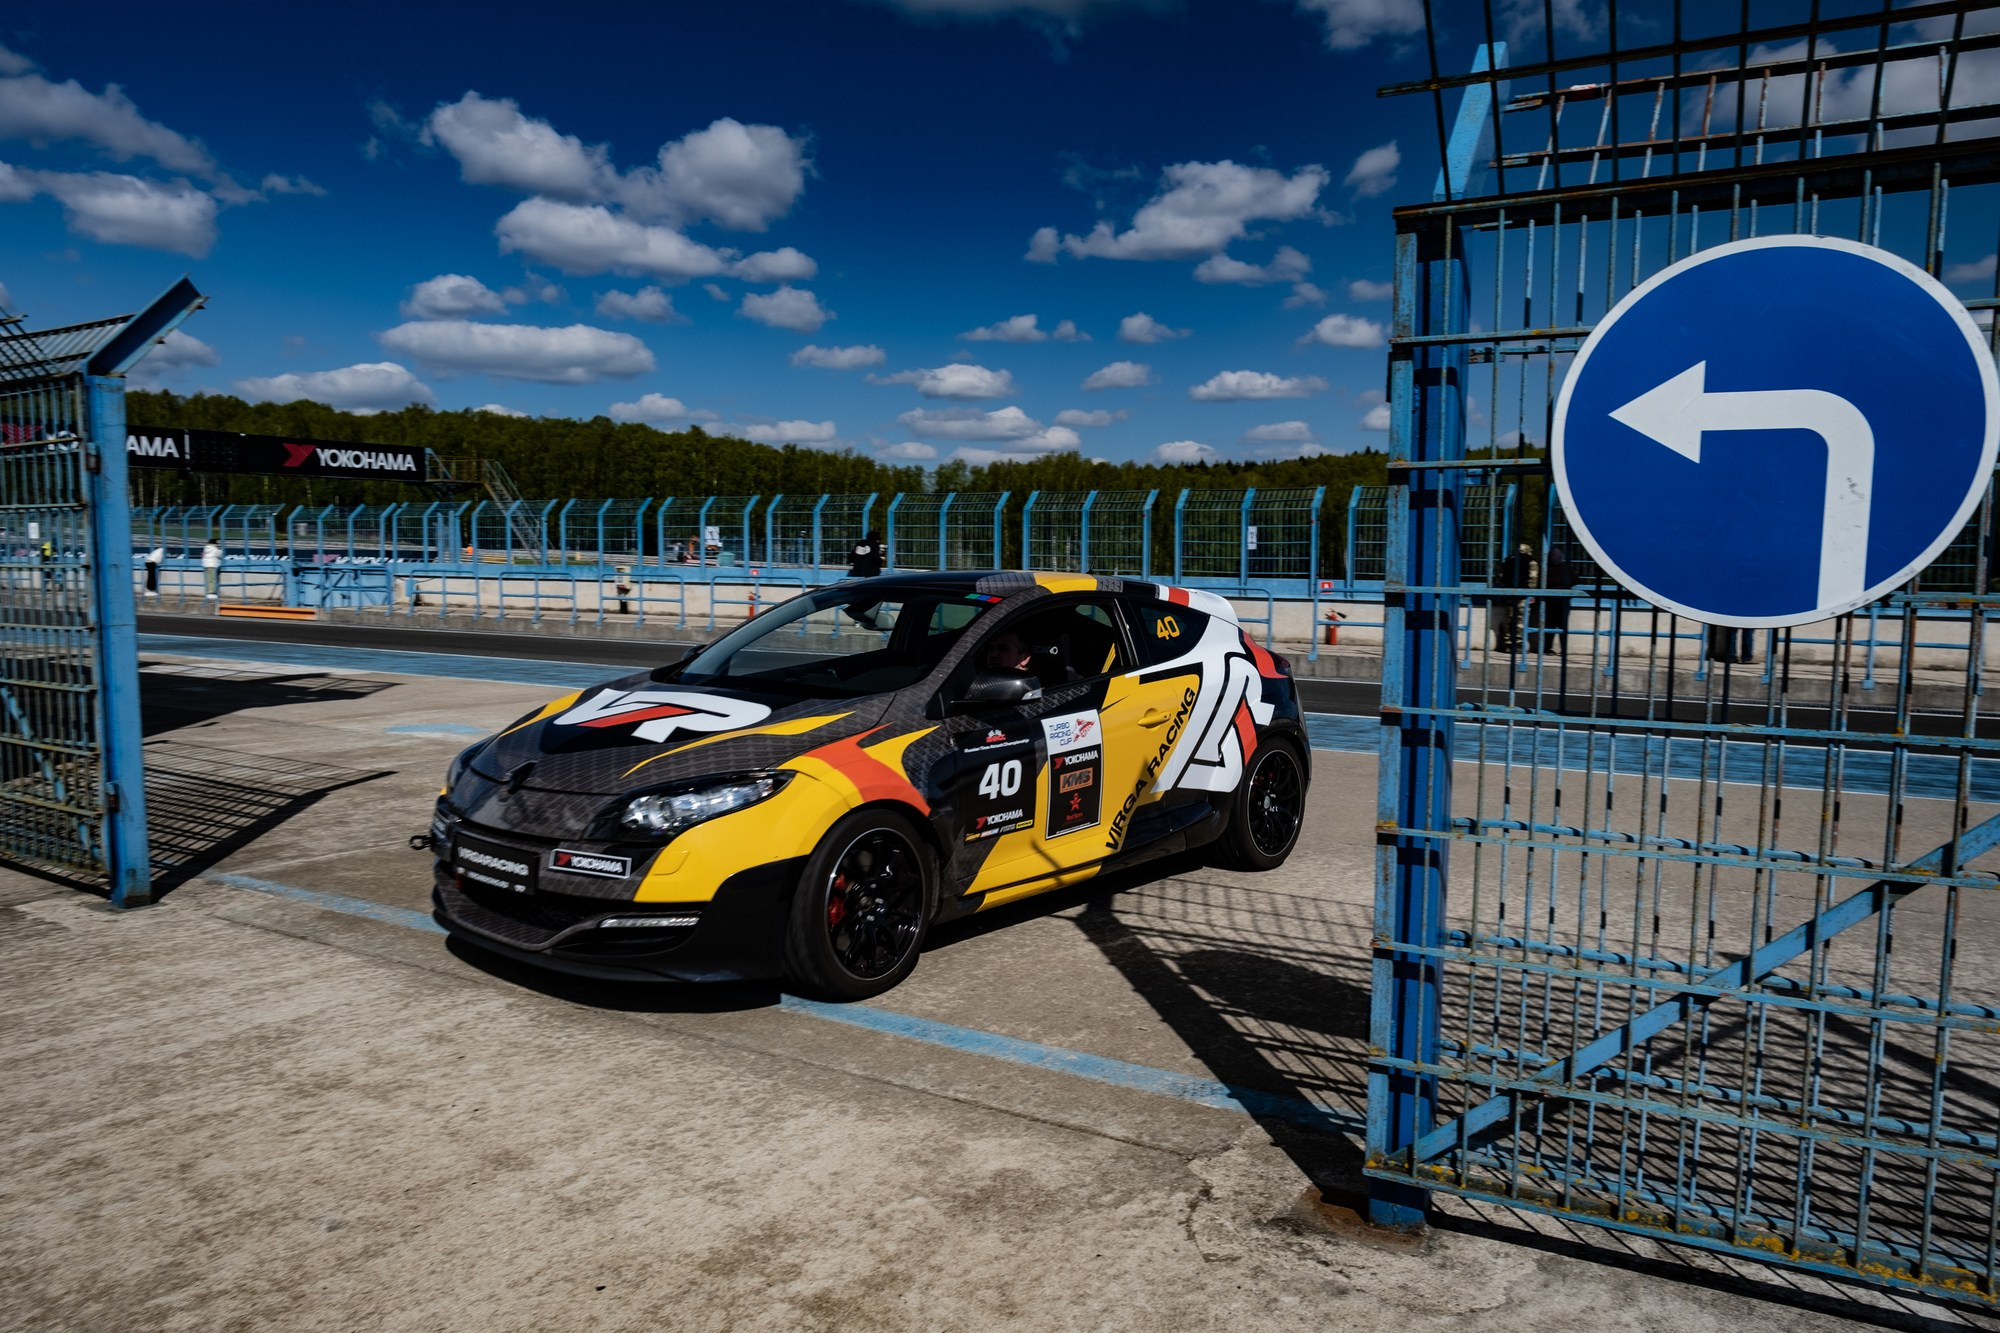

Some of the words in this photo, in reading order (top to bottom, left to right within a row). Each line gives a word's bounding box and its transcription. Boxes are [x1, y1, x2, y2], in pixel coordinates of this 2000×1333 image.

[315, 447, 417, 472] YOKOHAMA
[1156, 615, 1180, 640] 40
[1049, 721, 1070, 731] TURBO
[1050, 729, 1072, 740] RACING
[1060, 737, 1072, 746] CUP
[1064, 750, 1099, 765] YOKOHAMA
[1105, 778, 1148, 851] VIRGA
[1146, 687, 1197, 778] RACING
[978, 759, 1022, 800] 40
[1061, 770, 1092, 789] KMS
[986, 809, 1024, 826] YOKOHAMA
[570, 855, 624, 873] YOKOHAMA
